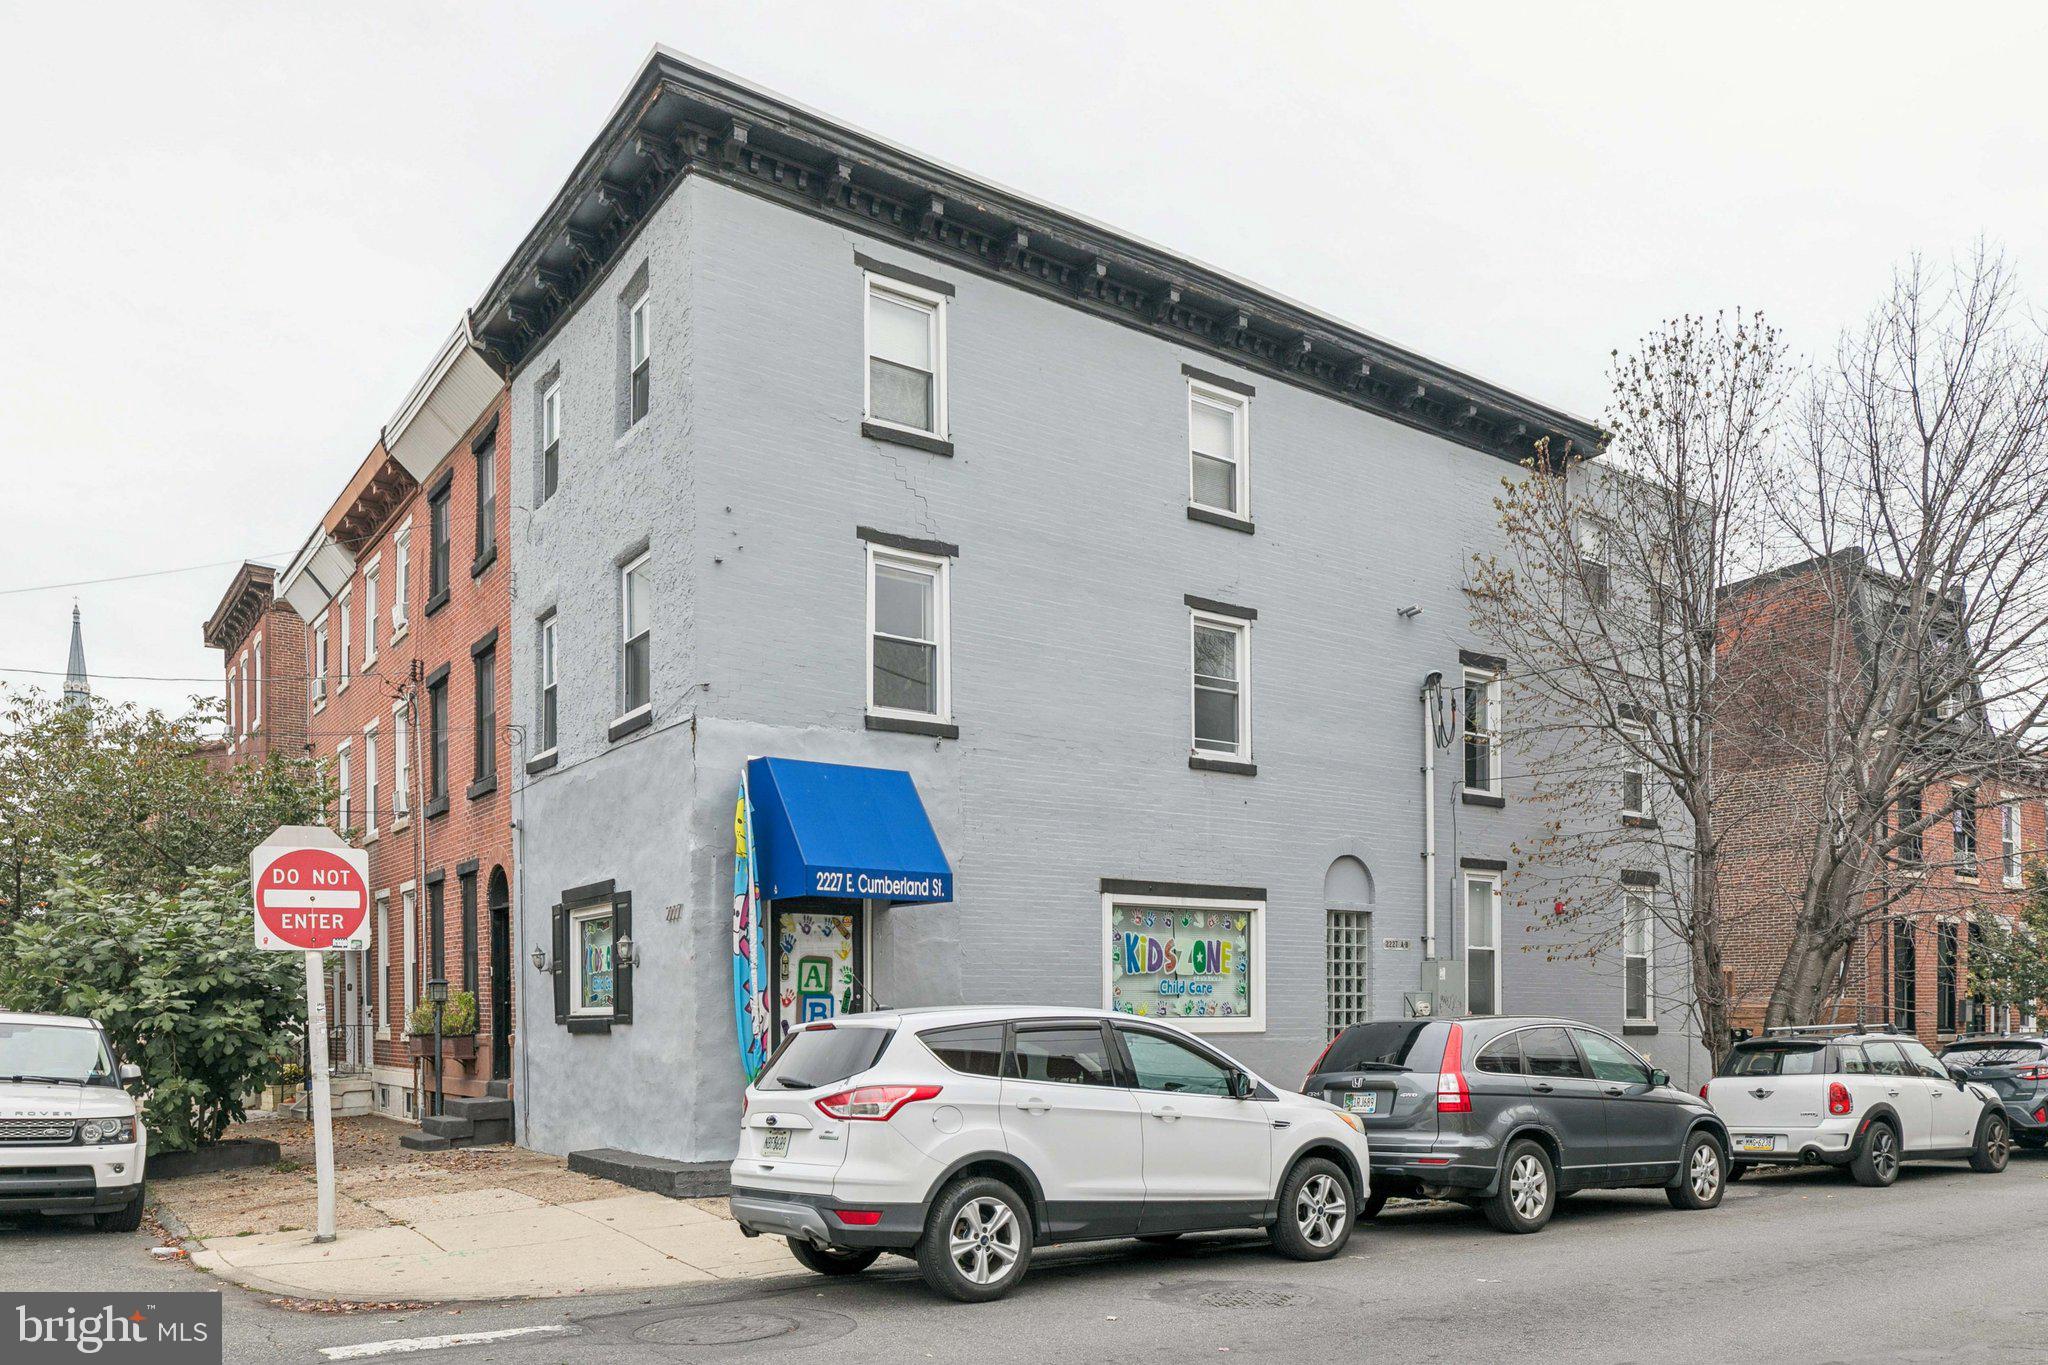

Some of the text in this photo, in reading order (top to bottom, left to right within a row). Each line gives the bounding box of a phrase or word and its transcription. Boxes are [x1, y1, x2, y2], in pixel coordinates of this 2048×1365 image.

[273, 869, 351, 885] DO NOT
[816, 872, 945, 897] 2227 E. Cumberland St.
[281, 914, 344, 929] ENTER
[804, 965, 823, 987] A
[1160, 980, 1213, 995] Child Care
[809, 1002, 827, 1022] B
